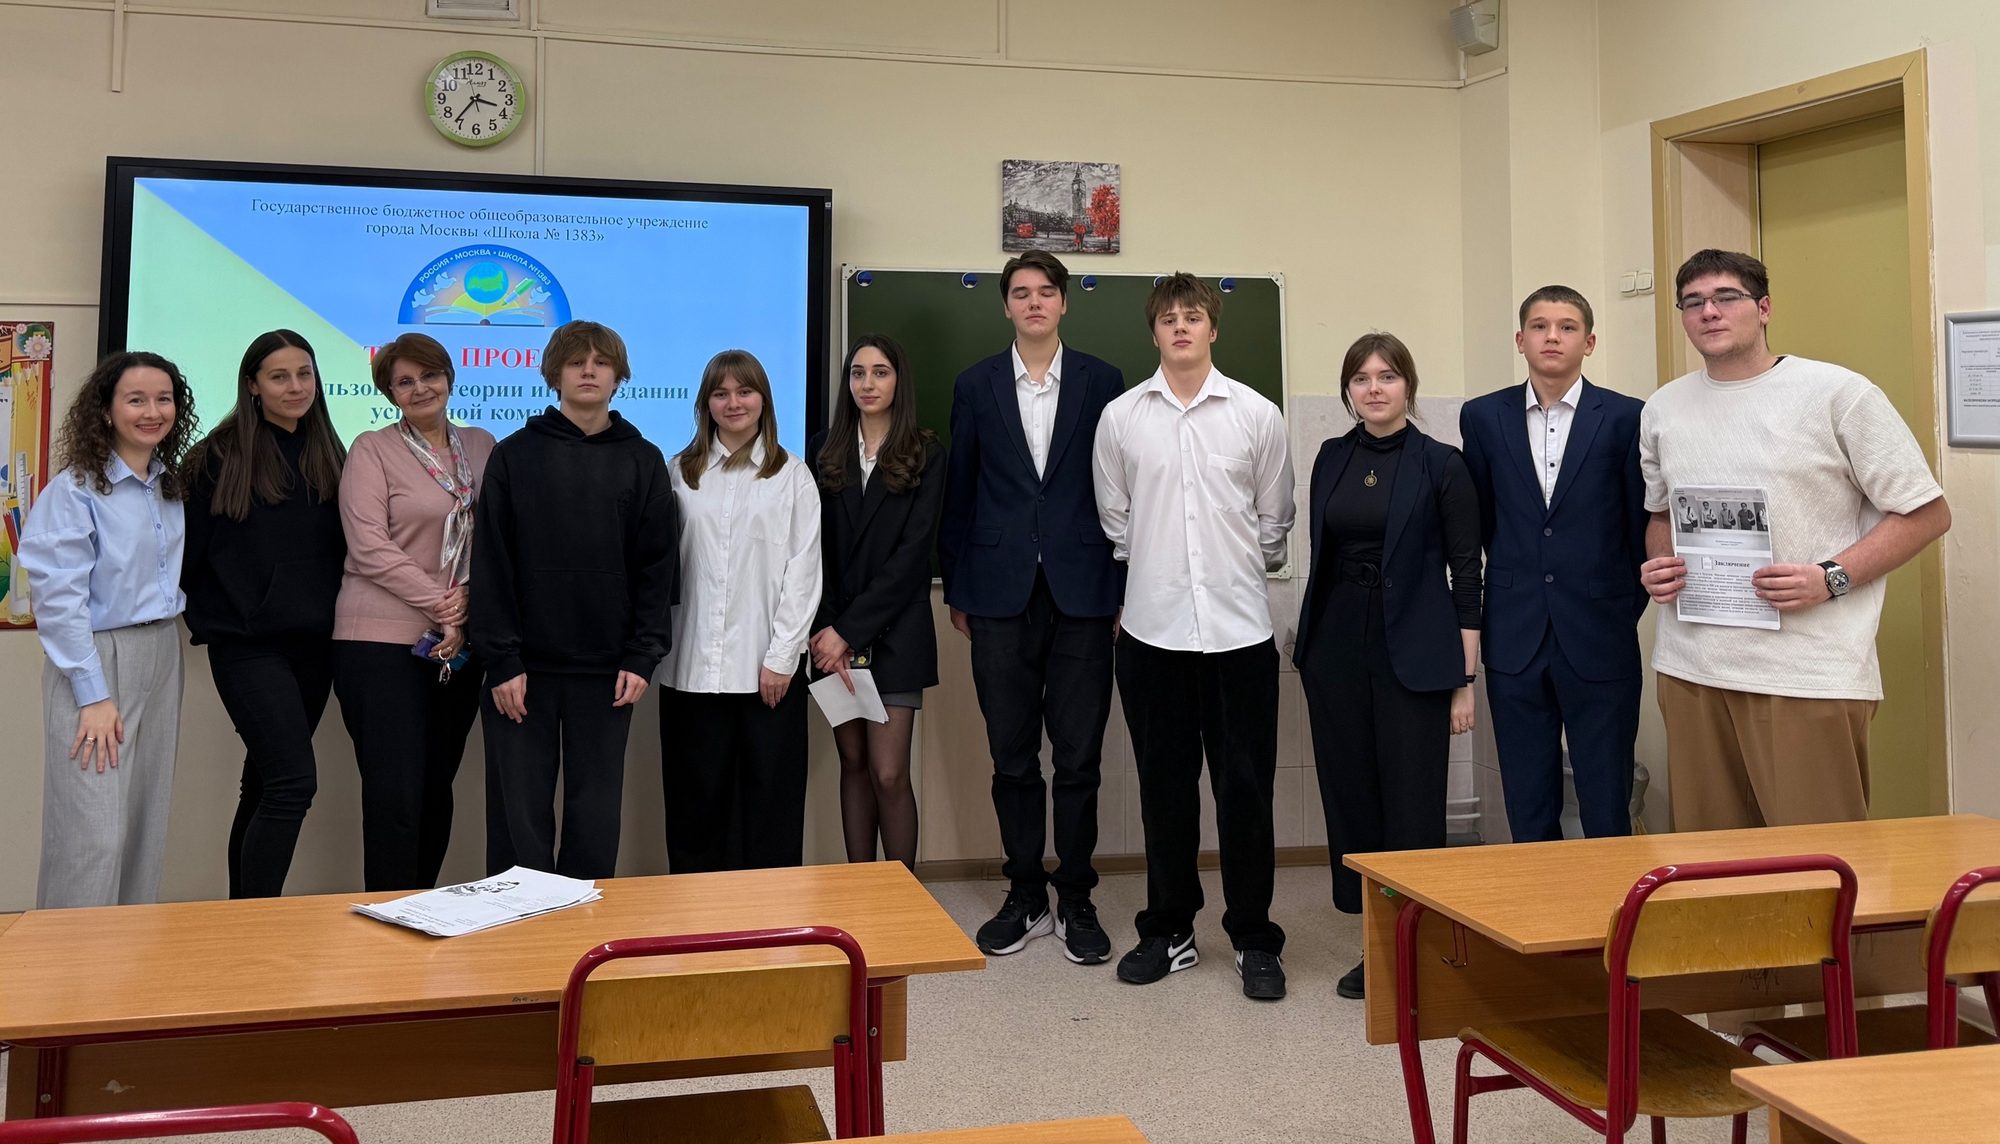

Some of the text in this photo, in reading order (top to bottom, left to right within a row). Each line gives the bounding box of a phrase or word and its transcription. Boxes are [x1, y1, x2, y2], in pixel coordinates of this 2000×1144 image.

[452, 67, 468, 80] 11
[466, 63, 483, 75] 12
[487, 68, 495, 80] 1
[441, 80, 457, 92] 10
[498, 80, 507, 92] 2
[437, 92, 446, 105] 9
[505, 94, 513, 106] 3
[443, 106, 453, 118] 8
[498, 107, 508, 119] 4
[456, 118, 464, 130] 7
[472, 123, 481, 135] 6
[489, 119, 497, 131] 5
[251, 198, 709, 230] Государственное бюджетное общеобразовательное учреждение
[366, 223, 605, 241] города Москвы «Школа № 1383»
[419, 257, 450, 283] РОССИЯ
[454, 249, 491, 260] МОСКВА
[498, 250, 529, 267] ШКОЛА
[461, 347, 541, 369] ПРОЕ
[617, 385, 689, 400] здании
[490, 408, 543, 420] кома
